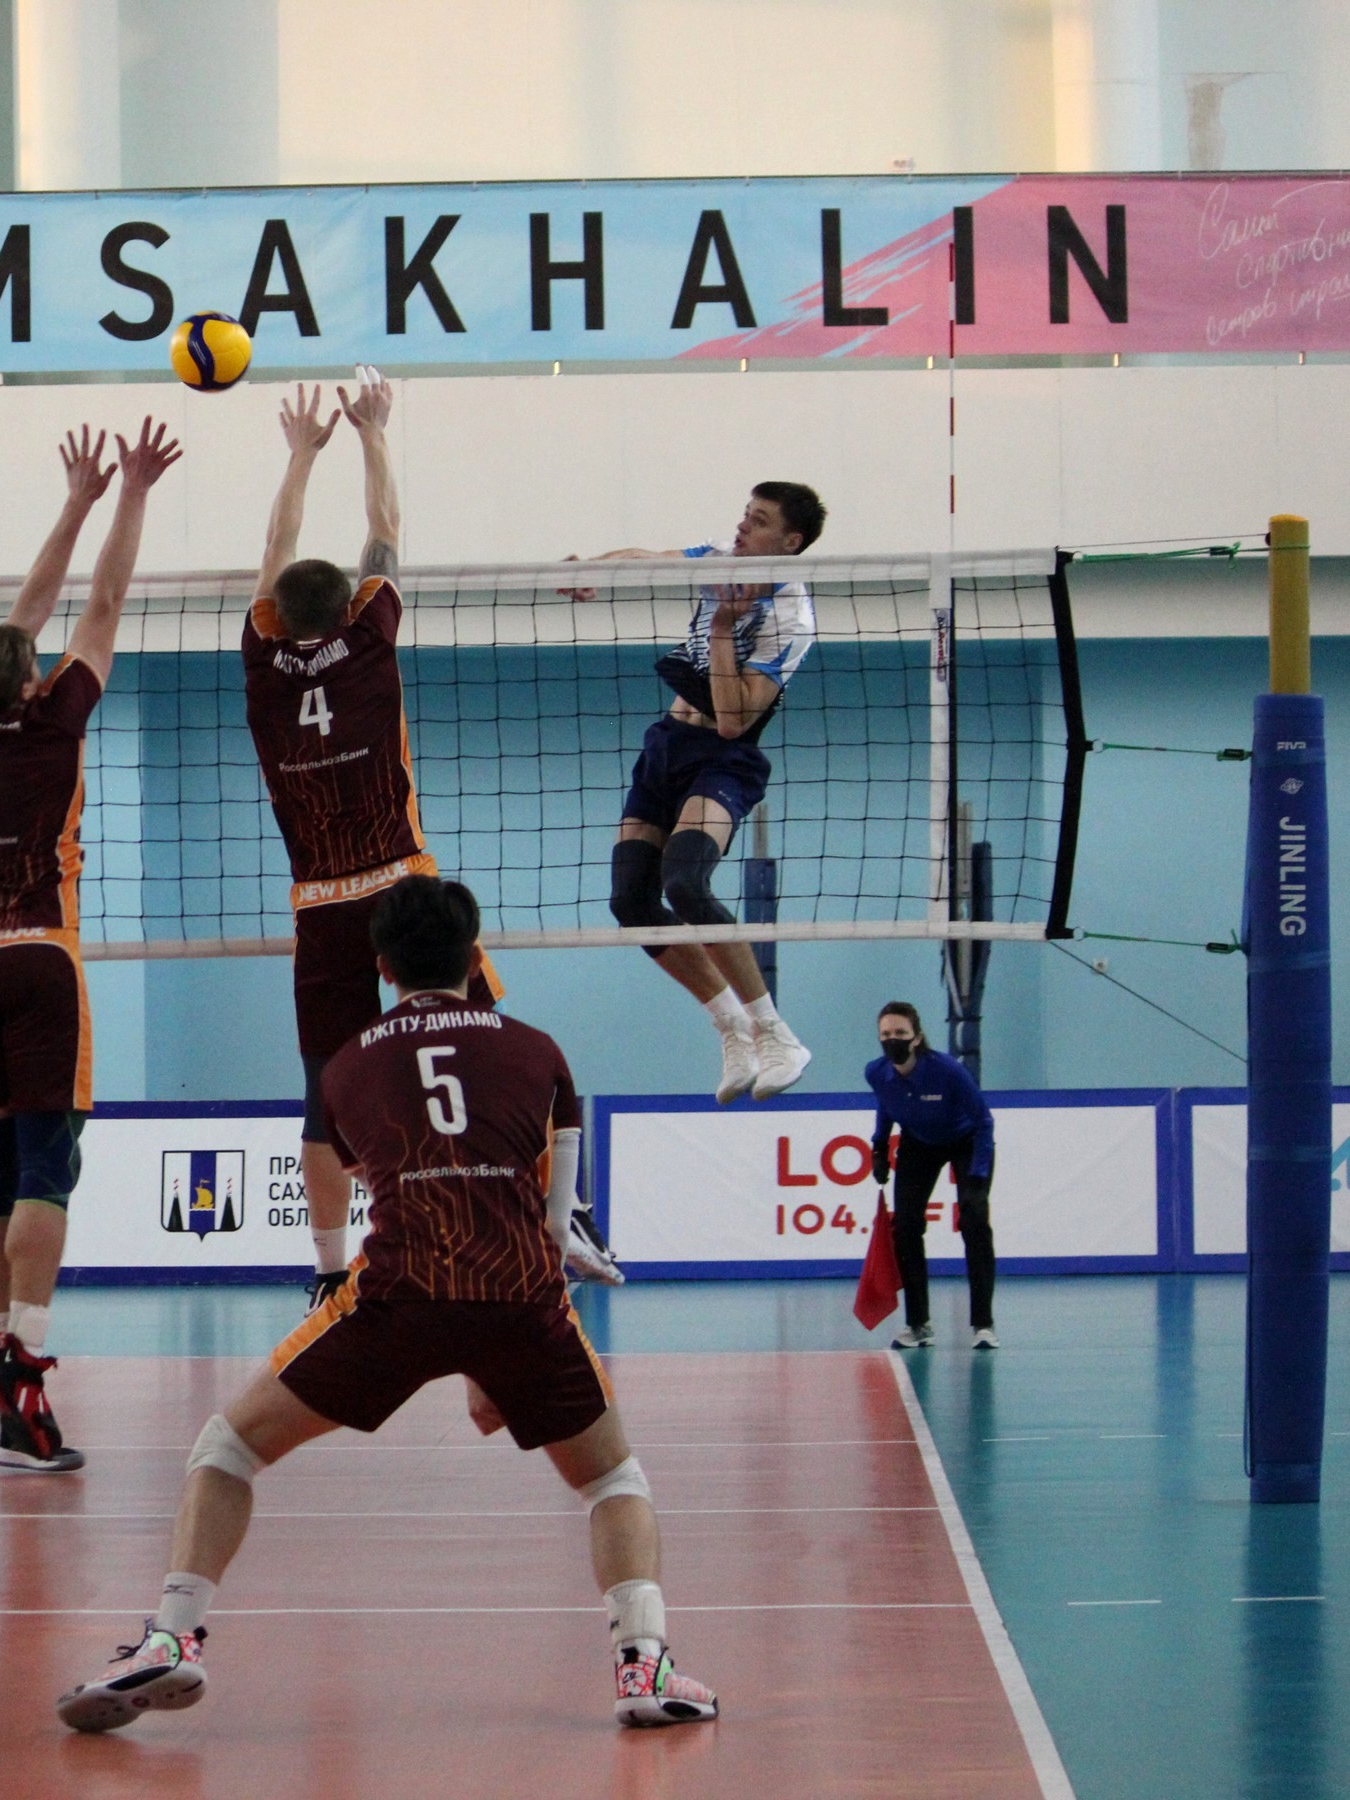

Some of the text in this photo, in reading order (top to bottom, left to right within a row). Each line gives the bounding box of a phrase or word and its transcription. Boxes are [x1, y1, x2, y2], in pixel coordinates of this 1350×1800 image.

[298, 685, 334, 737] 4
[300, 860, 410, 902] NEW LEAGUE
[1278, 816, 1307, 936] JINLING
[359, 1010, 503, 1049] ИЖГТУ-ДИНАМО
[416, 1045, 468, 1136] 5
